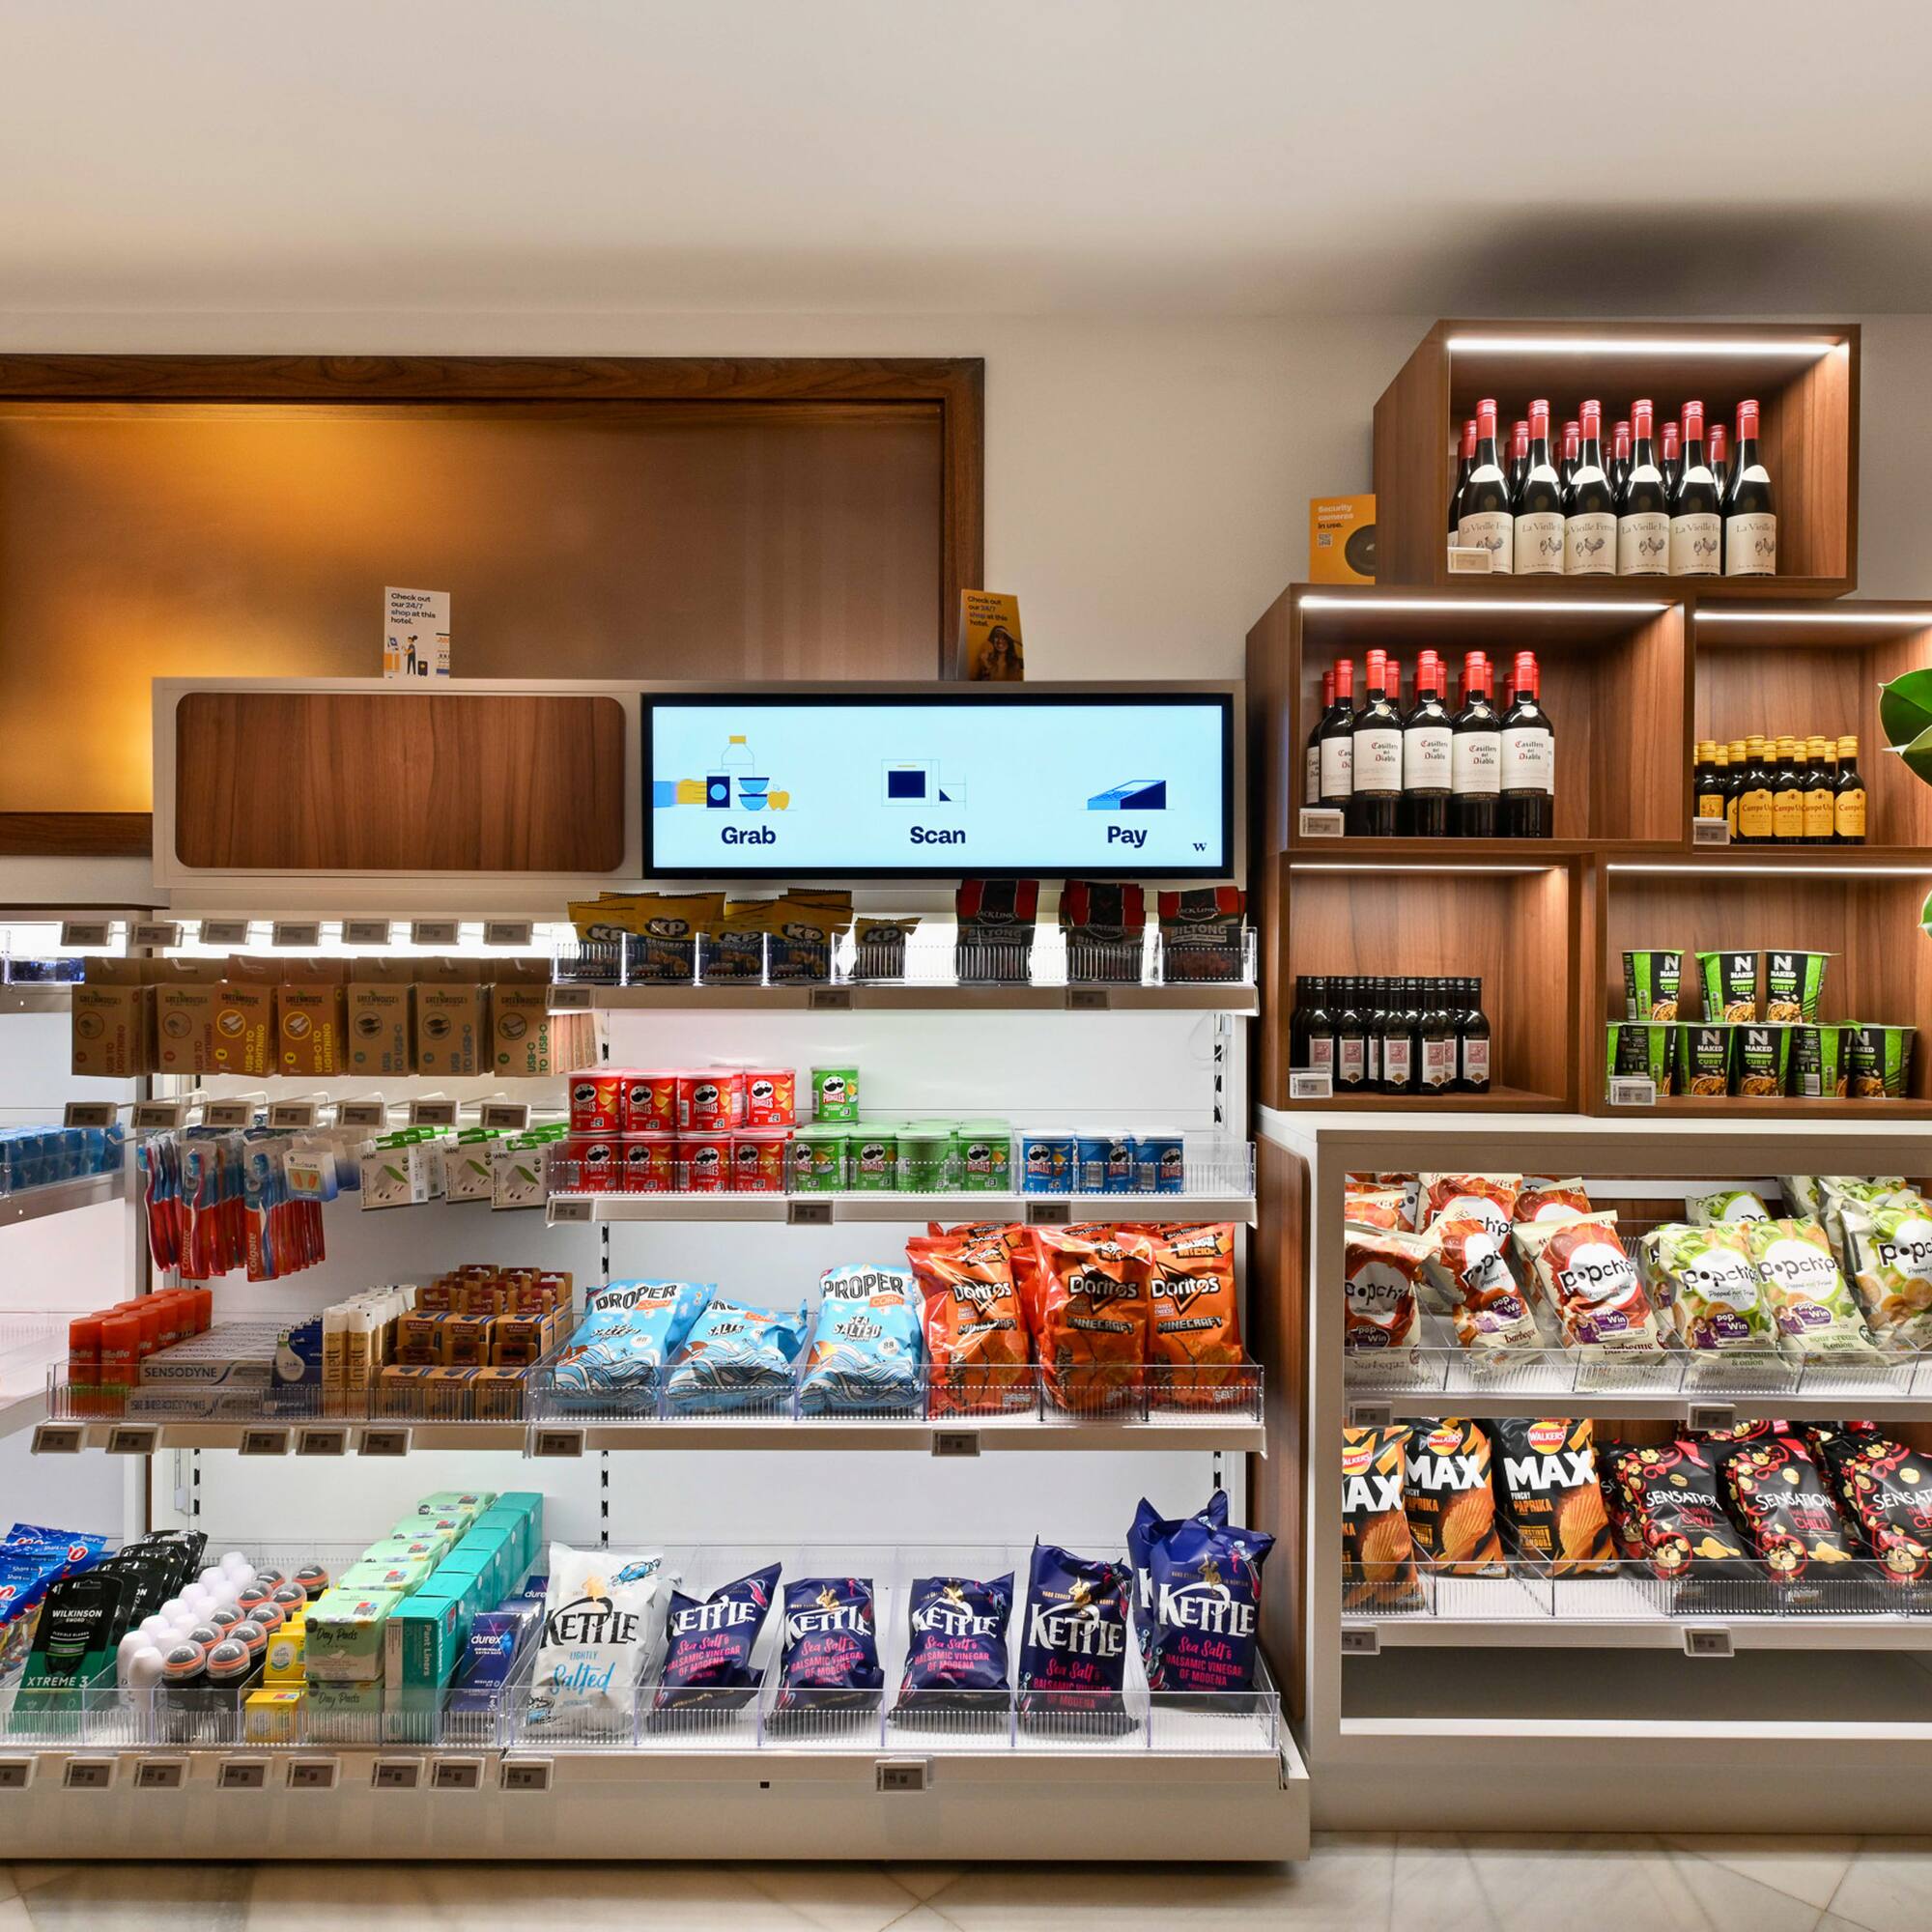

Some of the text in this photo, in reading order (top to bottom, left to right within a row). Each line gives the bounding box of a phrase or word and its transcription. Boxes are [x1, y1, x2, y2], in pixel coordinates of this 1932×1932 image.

[1318, 503, 1352, 513] Security
[1533, 522, 1556, 531] Vieille
[1570, 523, 1593, 532] Vieille
[1633, 522, 1658, 531] Vieille
[1687, 522, 1711, 531] Vieille
[390, 592, 417, 602] Check
[967, 595, 989, 604] Check
[390, 609, 411, 618] shop
[390, 616, 413, 625] hotel.
[1375, 753, 1396, 762] Diablo
[1473, 756, 1494, 765] Diablo
[721, 824, 1148, 848] Grab Scan Pay
[591, 927, 625, 941] KP
[650, 920, 686, 935] KP
[788, 925, 821, 939] KP
[968, 927, 1022, 937] BILTONG
[1171, 923, 1228, 936] BILTONG
[724, 933, 758, 943] KP
[867, 929, 897, 942] KP
[1663, 954, 1679, 970] N
[1734, 955, 1752, 971] N
[1774, 955, 1793, 970] N
[246, 1030, 255, 1042] TO
[313, 1030, 322, 1042] TO
[1702, 1030, 1720, 1045] N
[1747, 1030, 1769, 1045] N
[1855, 1031, 1870, 1046] N
[255, 1023, 266, 1073] LIGHTNING
[324, 1023, 332, 1072] LIGHTNING
[539, 1024, 549, 1072] TO USB-C
[383, 1052, 391, 1072] USB
[450, 1052, 461, 1072] USB
[526, 1041, 536, 1072] USB-C
[394, 1059, 403, 1072] TO
[463, 1059, 472, 1072] TO
[752, 1097, 773, 1108] PRINGLES
[823, 1092, 845, 1104] PRINGLES
[574, 1101, 596, 1113] PRINGLES
[630, 1103, 652, 1114] PRINGLES
[694, 1102, 718, 1114] PRINGLES
[182, 1229, 191, 1271] Colgate
[248, 1232, 258, 1275] Colgate
[1560, 1259, 1634, 1293] popchip
[1679, 1265, 1757, 1291] popchips
[822, 1271, 904, 1299] PROPER
[1068, 1275, 1138, 1299] Doritos
[1150, 1276, 1220, 1300] Doritos
[594, 1284, 677, 1312] PROPER
[952, 1281, 1012, 1304] Doritos
[869, 1296, 901, 1306] CORN
[1492, 1296, 1510, 1308] pop
[1797, 1304, 1814, 1313] pop
[1808, 1309, 1829, 1319] Win
[848, 1315, 868, 1325] SEA
[1065, 1316, 1135, 1334] MINECRAFT
[1156, 1317, 1223, 1333] MINECRAFT
[1606, 1314, 1626, 1324] Win
[1717, 1313, 1735, 1323] pop
[832, 1321, 881, 1339] SALTED
[1358, 1325, 1377, 1334] pop
[1727, 1321, 1747, 1331] Win
[882, 1340, 895, 1350] 88
[1367, 1333, 1387, 1343] Win
[1739, 1357, 1764, 1367] onion
[144, 1367, 217, 1378] SENSODYNE
[1427, 1434, 1462, 1445] WALKERS
[1528, 1431, 1565, 1443] WALKERS
[1405, 1455, 1487, 1491] MAX
[1503, 1450, 1599, 1492] MAX
[1514, 1498, 1553, 1515] PAPRIKA
[1794, 1516, 1832, 1531] CHILLI
[51, 1609, 102, 1618] WILKINSON
[1159, 1580, 1255, 1638] KETTLE
[541, 1595, 639, 1648] KETTLE
[911, 1597, 1000, 1638] KETTLE
[784, 1606, 871, 1651] KETTLE
[1028, 1601, 1123, 1658] KETTLE
[316, 1627, 358, 1646] Day Pads
[470, 1634, 501, 1644] durex
[923, 1635, 972, 1651] Sea Salt
[423, 1624, 432, 1677] Pant Liners
[676, 1634, 724, 1656] Sea Salt
[705, 1644, 742, 1659] VINEGAR
[801, 1637, 847, 1656] Sea Salt
[1179, 1635, 1225, 1660] Sea Salt
[569, 1650, 598, 1661] LIGHTLY
[914, 1651, 990, 1665] BALSAMIC VINEGAR
[678, 1665, 690, 1677] OF
[804, 1666, 815, 1677] OF
[927, 1660, 975, 1672] OF MODENA
[1045, 1657, 1094, 1680] Sea Salt
[1164, 1654, 1244, 1677] BALSAMIC VINEGAR
[26, 1675, 89, 1688] XTREME 3
[551, 1662, 616, 1696] Salted
[1179, 1668, 1227, 1686] OF MODENA
[317, 1692, 360, 1708] Day Pads
